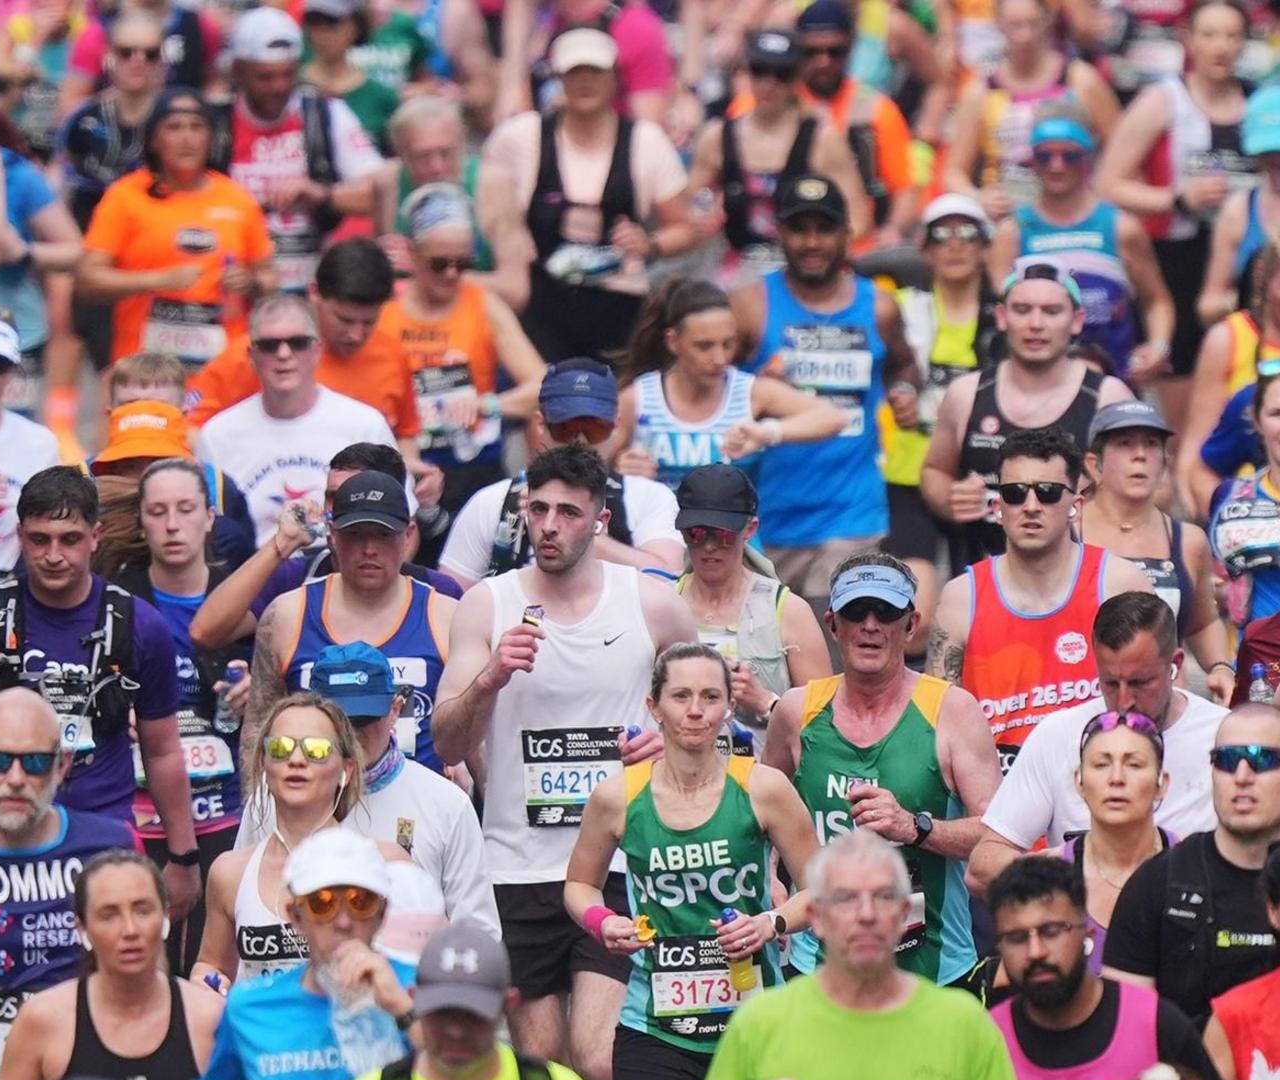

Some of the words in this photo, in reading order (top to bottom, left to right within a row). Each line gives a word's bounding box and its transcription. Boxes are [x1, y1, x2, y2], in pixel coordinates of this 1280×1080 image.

[979, 691, 1048, 720] Over
[527, 735, 563, 758] tcs
[566, 741, 618, 749] CONSULTANCY
[566, 749, 600, 757] SERVICES
[649, 839, 732, 873] ABBIE
[633, 863, 760, 908] NSPCC
[22, 930, 81, 950] RESEA
[241, 933, 280, 957] tcs
[23, 949, 50, 967] UK
[658, 943, 696, 967] tcs
[699, 956, 726, 965] SERVIC
[698, 1024, 718, 1034] new
